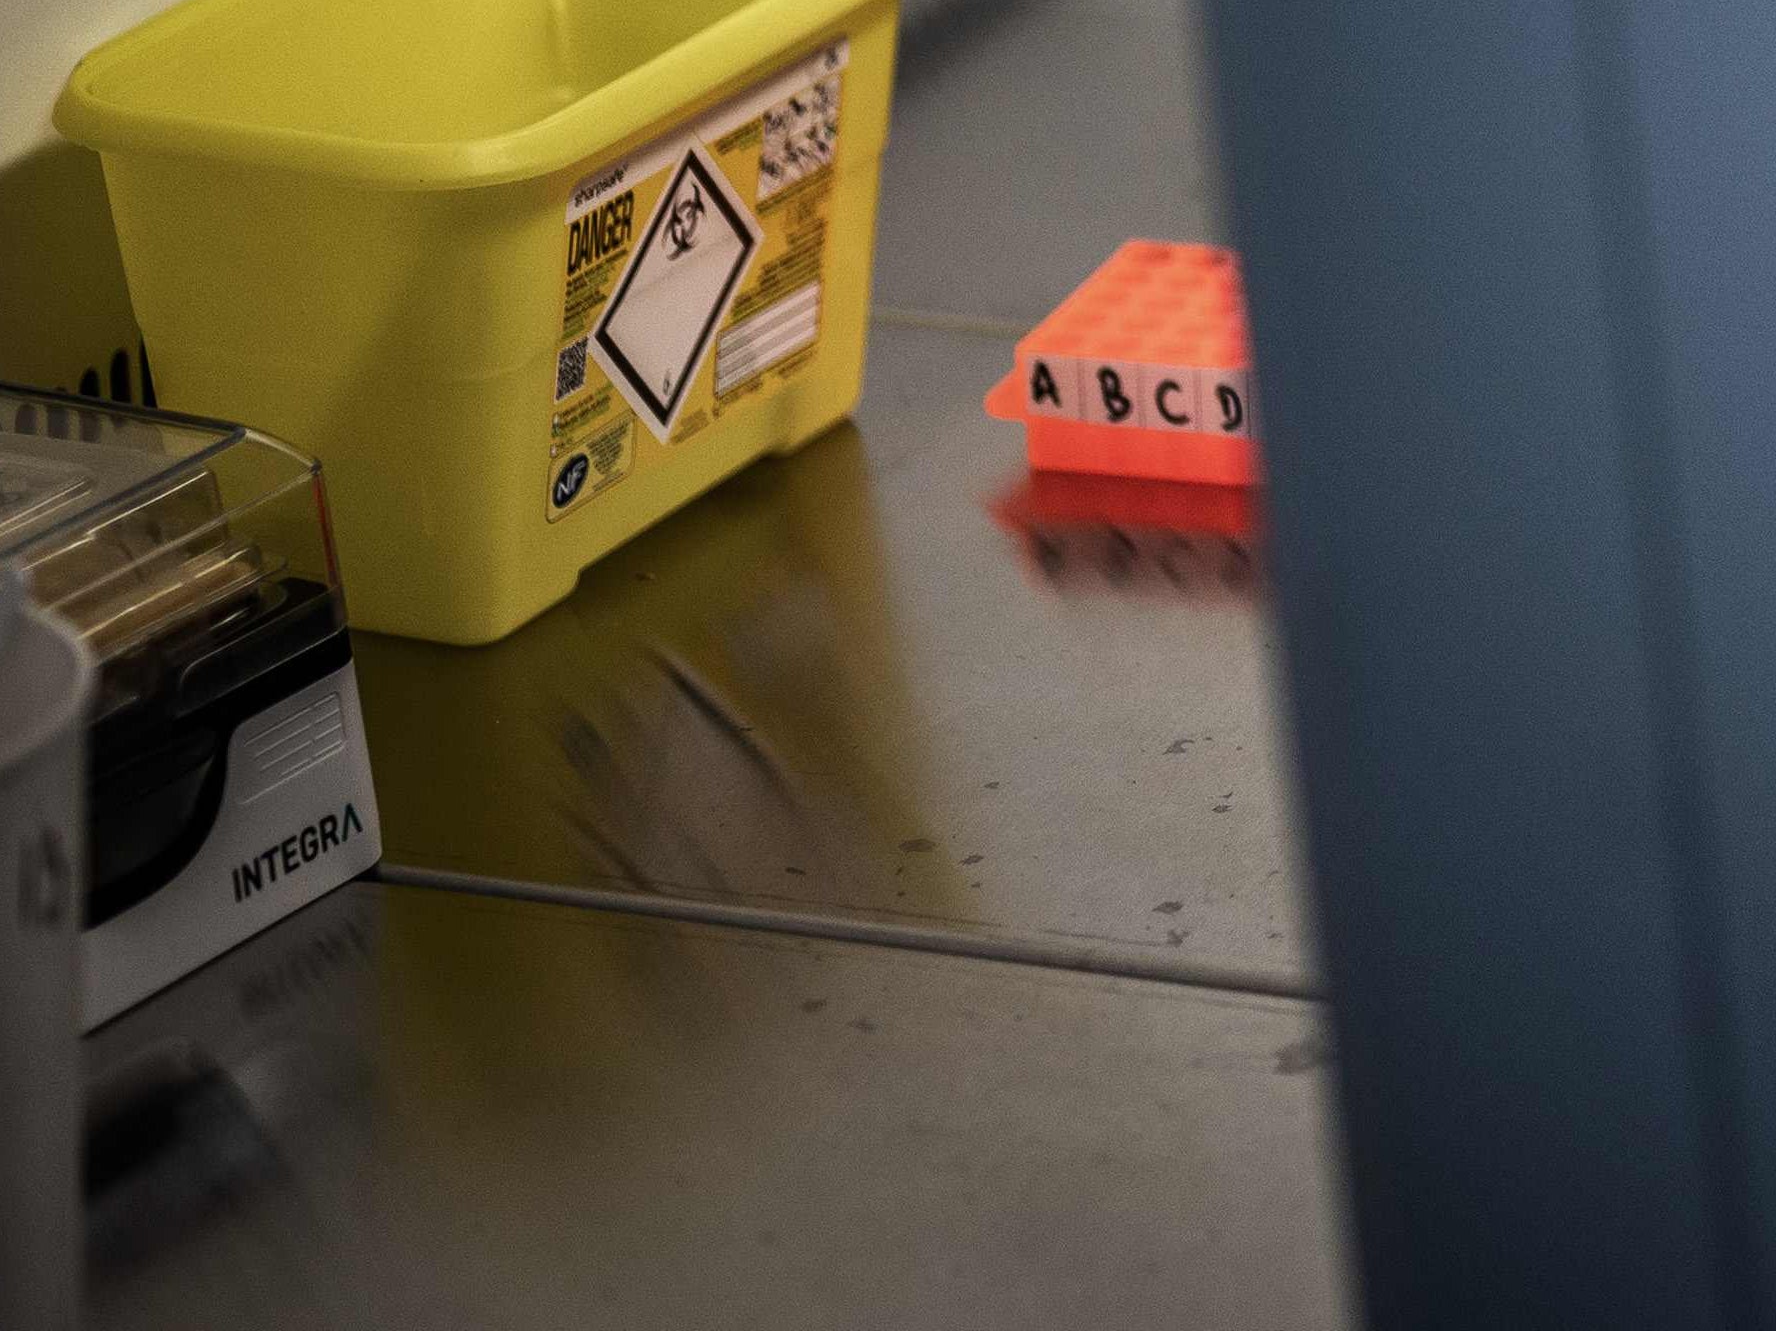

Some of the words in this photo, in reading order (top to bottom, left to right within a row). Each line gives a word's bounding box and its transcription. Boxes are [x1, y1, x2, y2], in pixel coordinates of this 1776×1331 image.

[567, 190, 634, 276] DANGER
[1030, 359, 1062, 408] A
[1097, 366, 1131, 423] B
[1155, 379, 1190, 425] C
[1216, 383, 1243, 431] D
[556, 460, 586, 501] NF
[232, 803, 363, 903] INTEGRA
